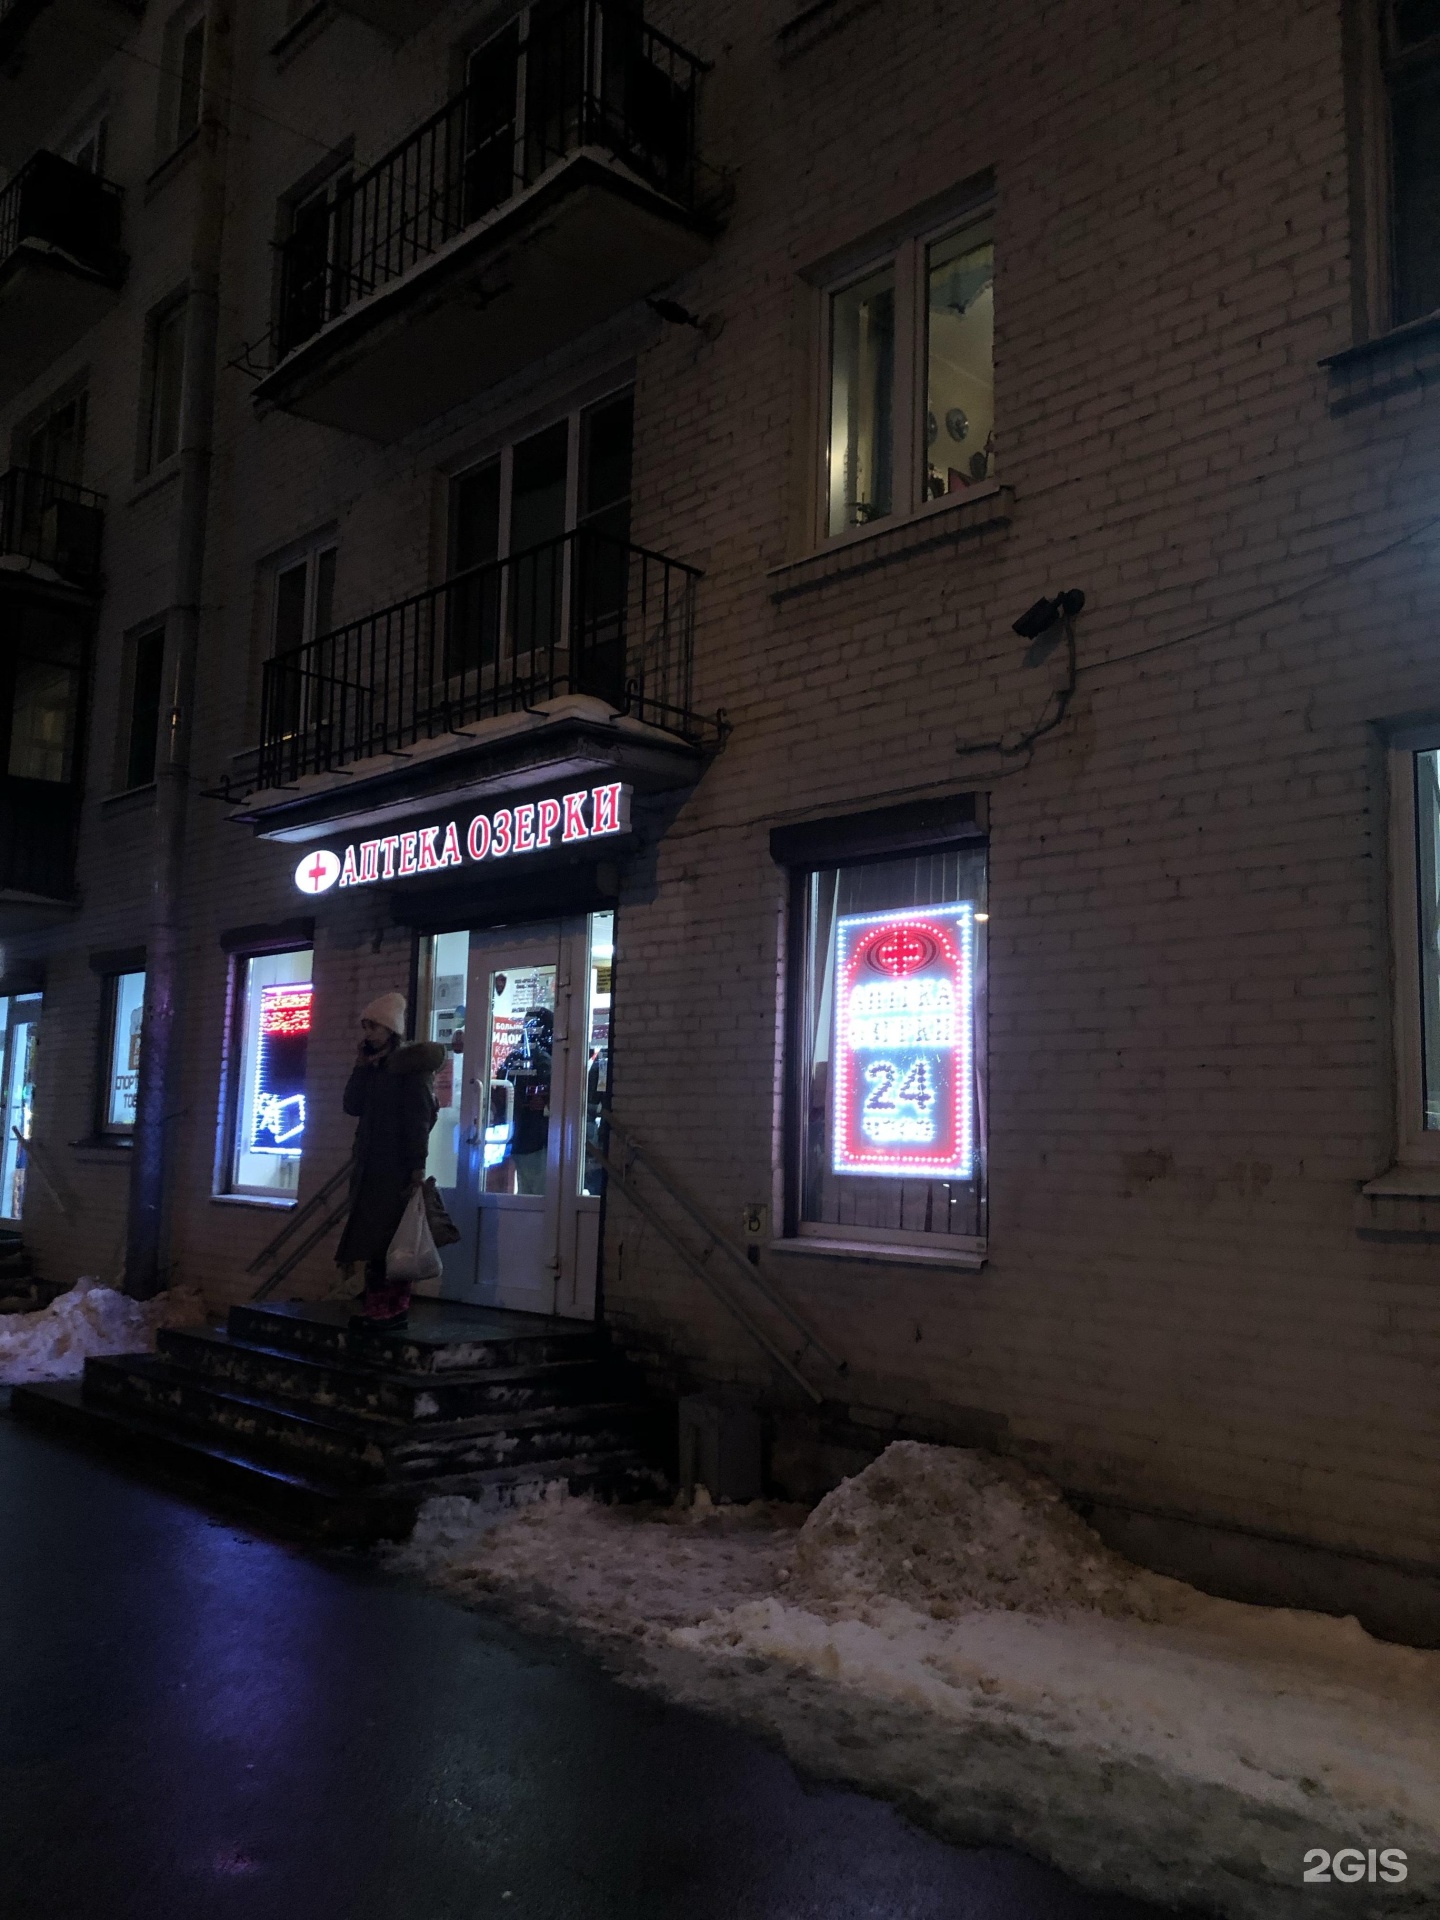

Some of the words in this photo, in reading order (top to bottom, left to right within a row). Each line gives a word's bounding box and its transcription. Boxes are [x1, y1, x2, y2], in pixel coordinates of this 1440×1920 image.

[339, 822, 462, 888] АПТЕКА
[467, 782, 622, 861] ОЗЕРКИ
[864, 1057, 935, 1113] 24
